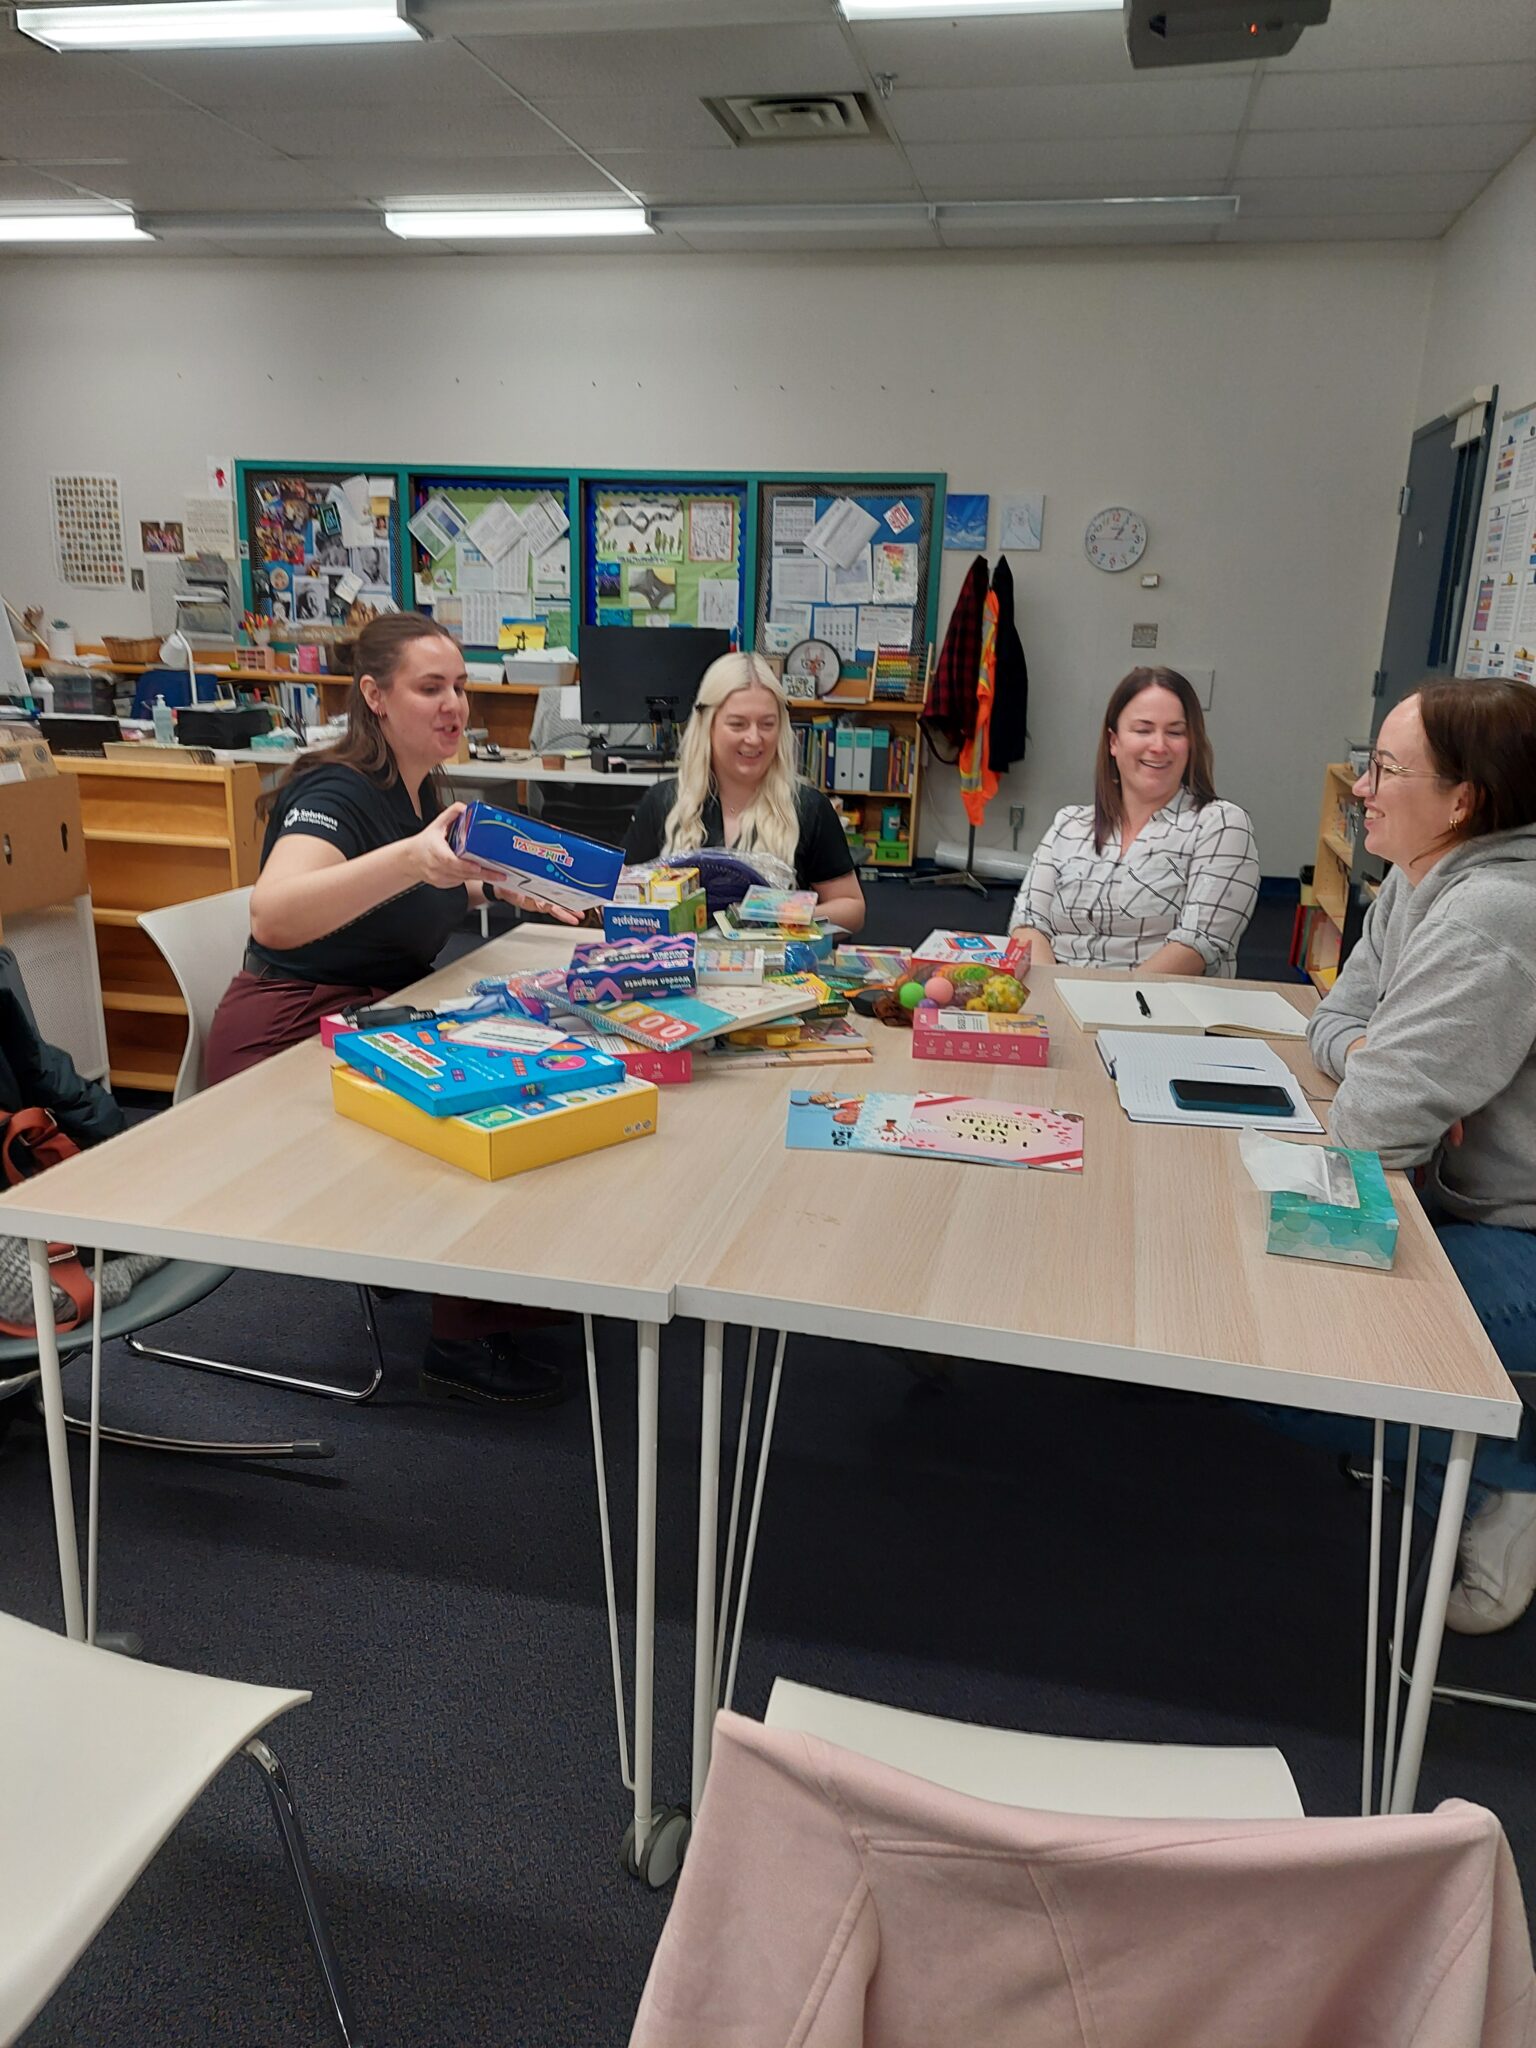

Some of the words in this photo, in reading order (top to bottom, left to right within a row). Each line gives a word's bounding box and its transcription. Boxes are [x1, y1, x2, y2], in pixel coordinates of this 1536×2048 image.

[612, 914, 661, 929] Pineapple
[623, 976, 659, 989] Magnets
[659, 975, 691, 986] Wooden
[945, 1115, 1042, 1134] CANADA
